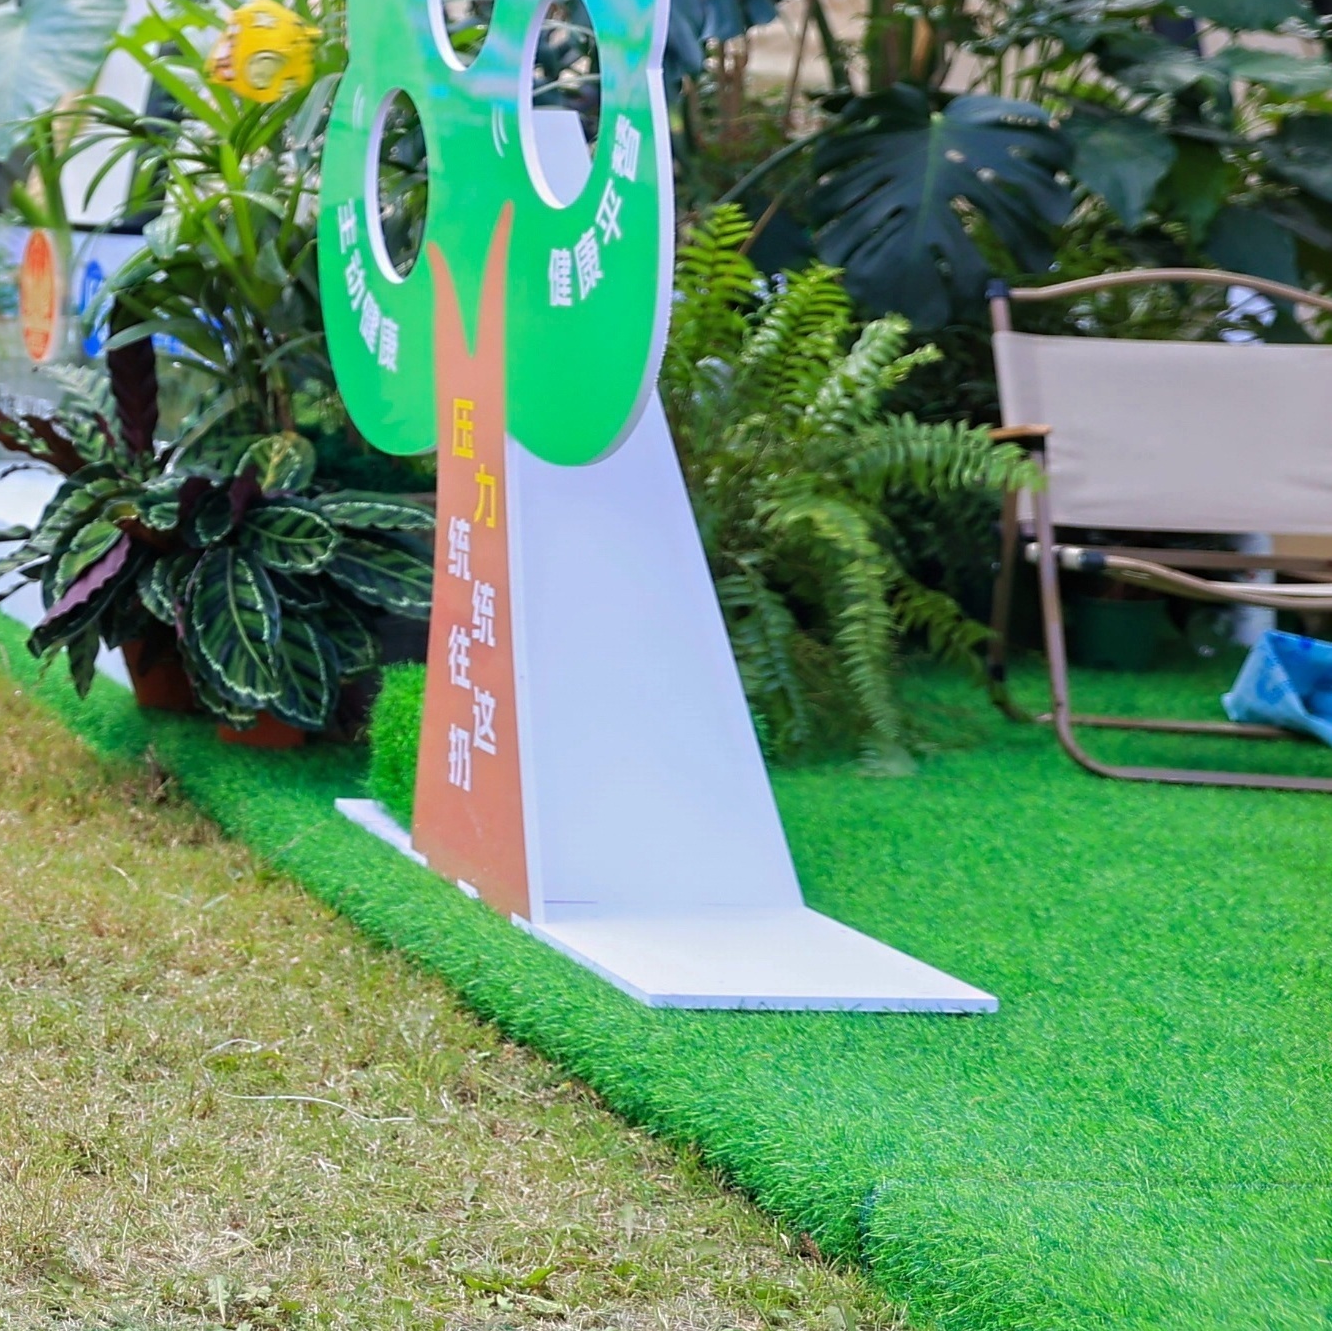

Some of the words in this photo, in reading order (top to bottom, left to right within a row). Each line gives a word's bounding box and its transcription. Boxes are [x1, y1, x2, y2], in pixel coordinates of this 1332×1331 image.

[337, 197, 400, 374] 主动健康
[548, 113, 641, 307] 健康平替
